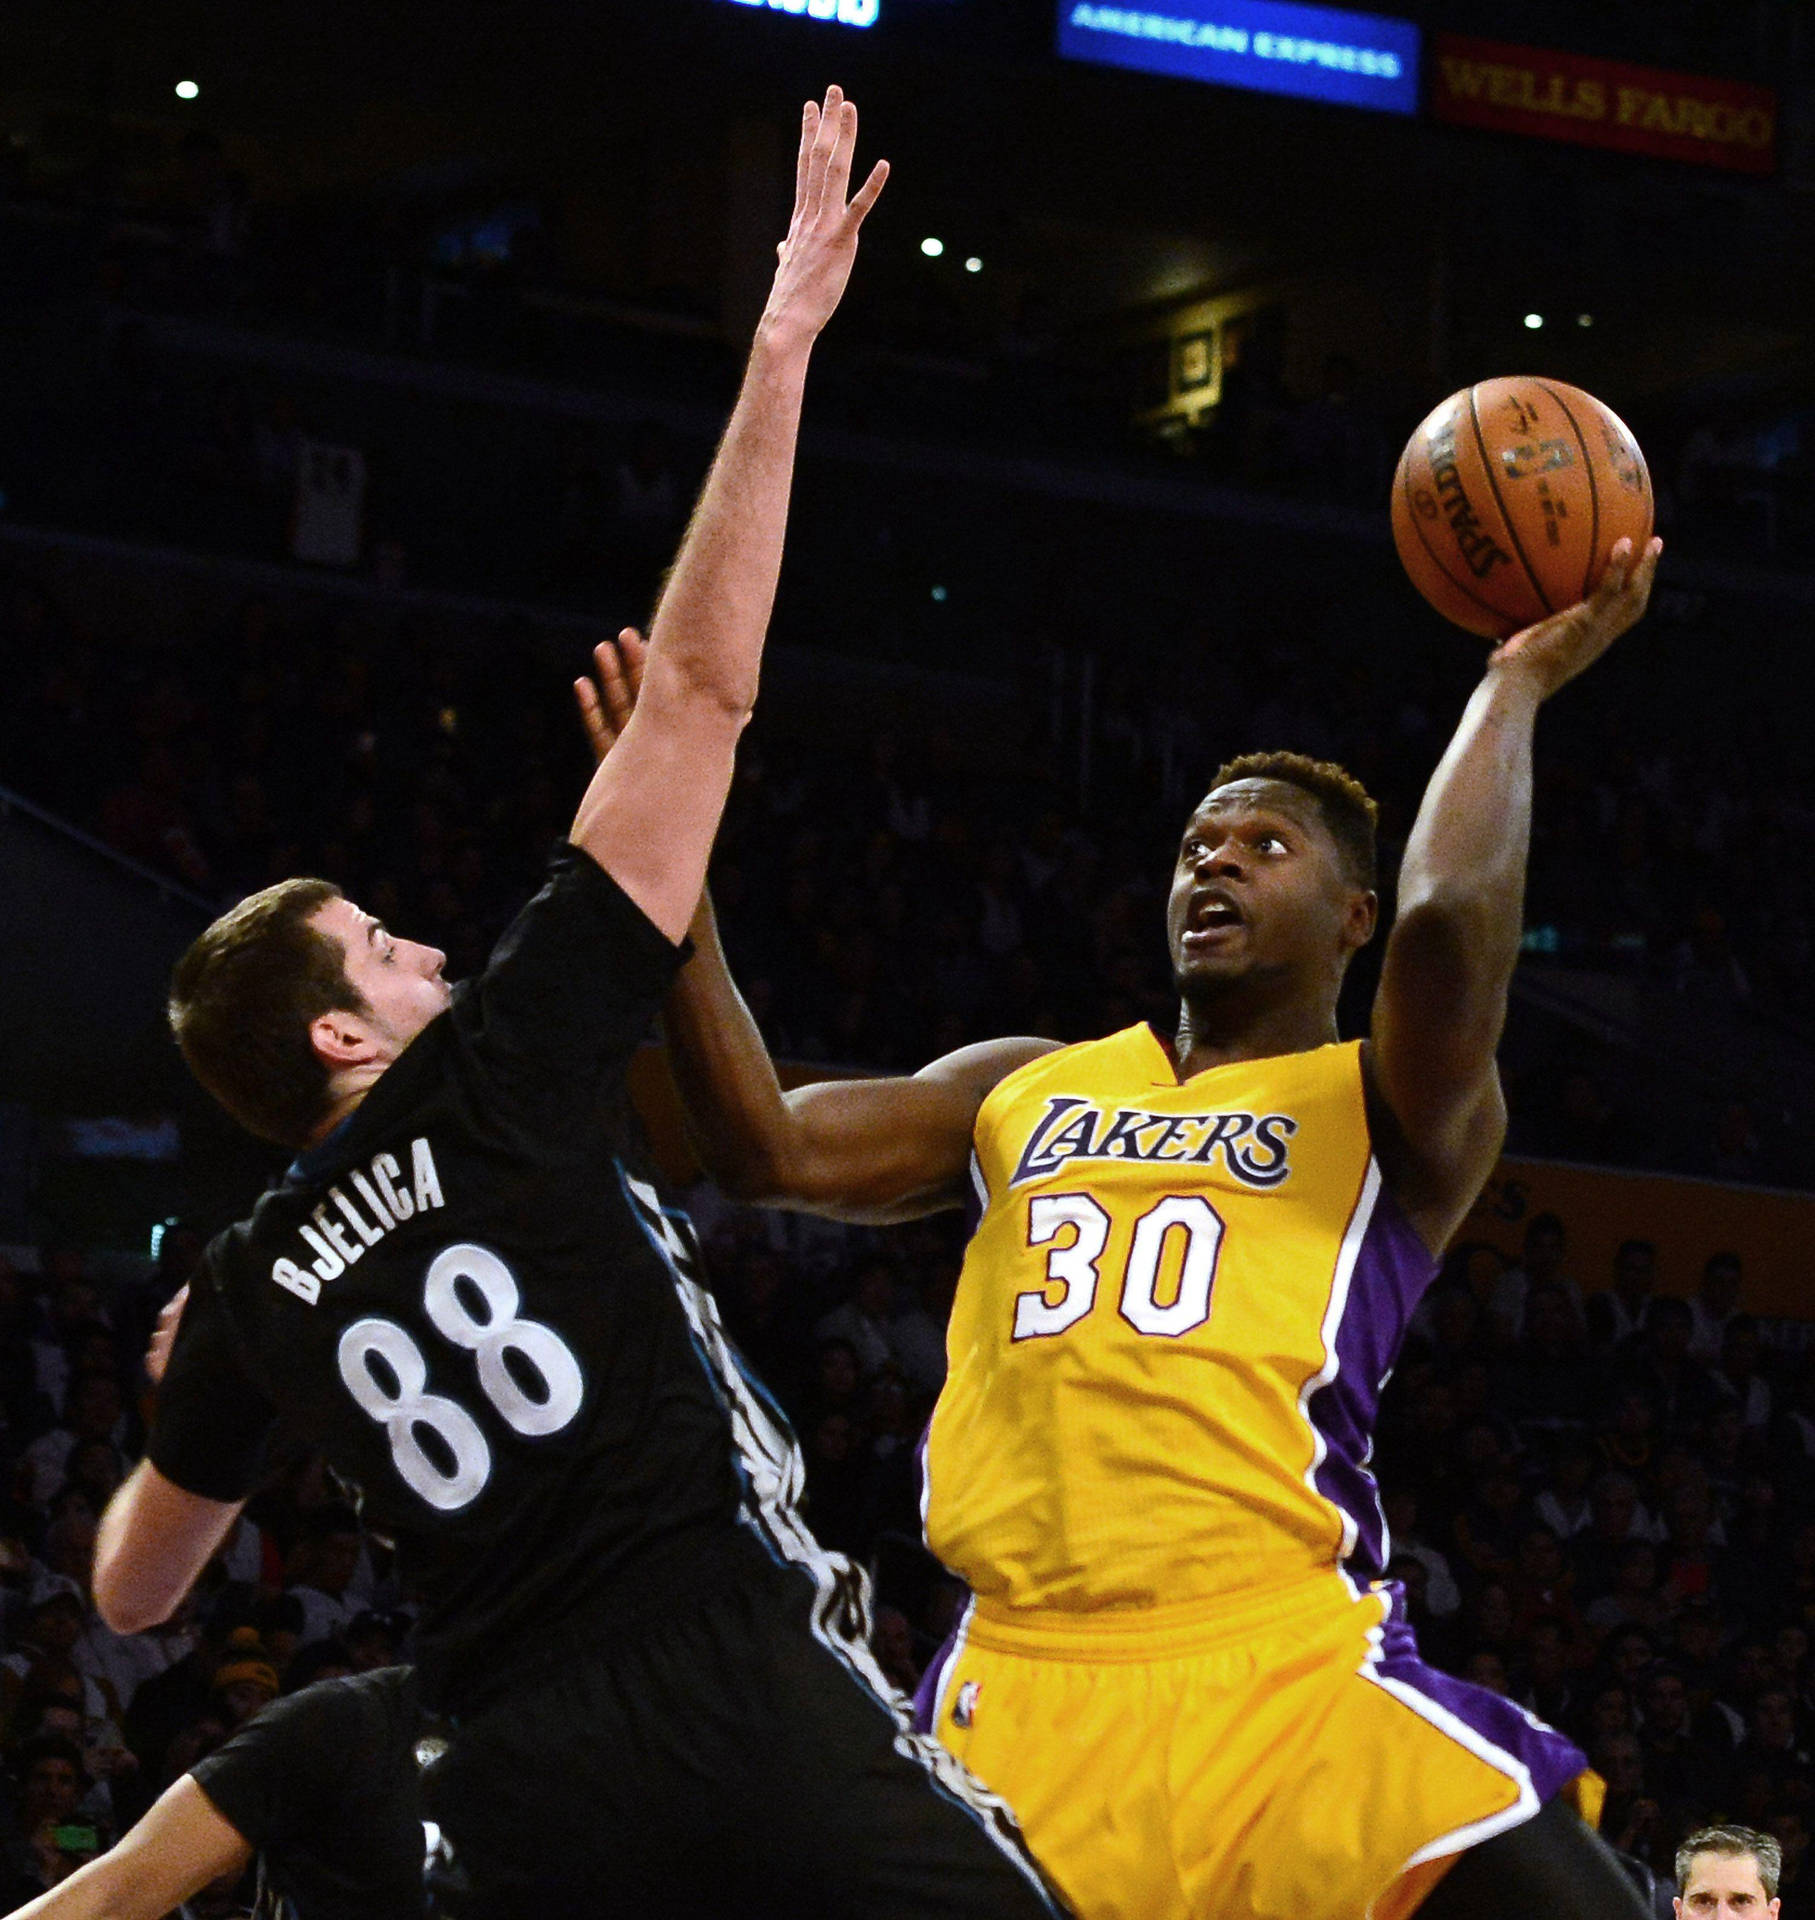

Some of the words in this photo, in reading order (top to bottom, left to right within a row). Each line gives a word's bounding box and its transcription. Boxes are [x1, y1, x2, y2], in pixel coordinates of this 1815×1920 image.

[1070, 3, 1249, 53] AMERICAN
[1253, 31, 1402, 78] EXPRESS
[1438, 55, 1607, 122] WELLS
[1616, 82, 1775, 147] FARGO
[1008, 1096, 1298, 1190] LAKERS
[271, 1137, 445, 1306] BJELICA
[1010, 1191, 1226, 1343] 30
[337, 1243, 584, 1511] 88
